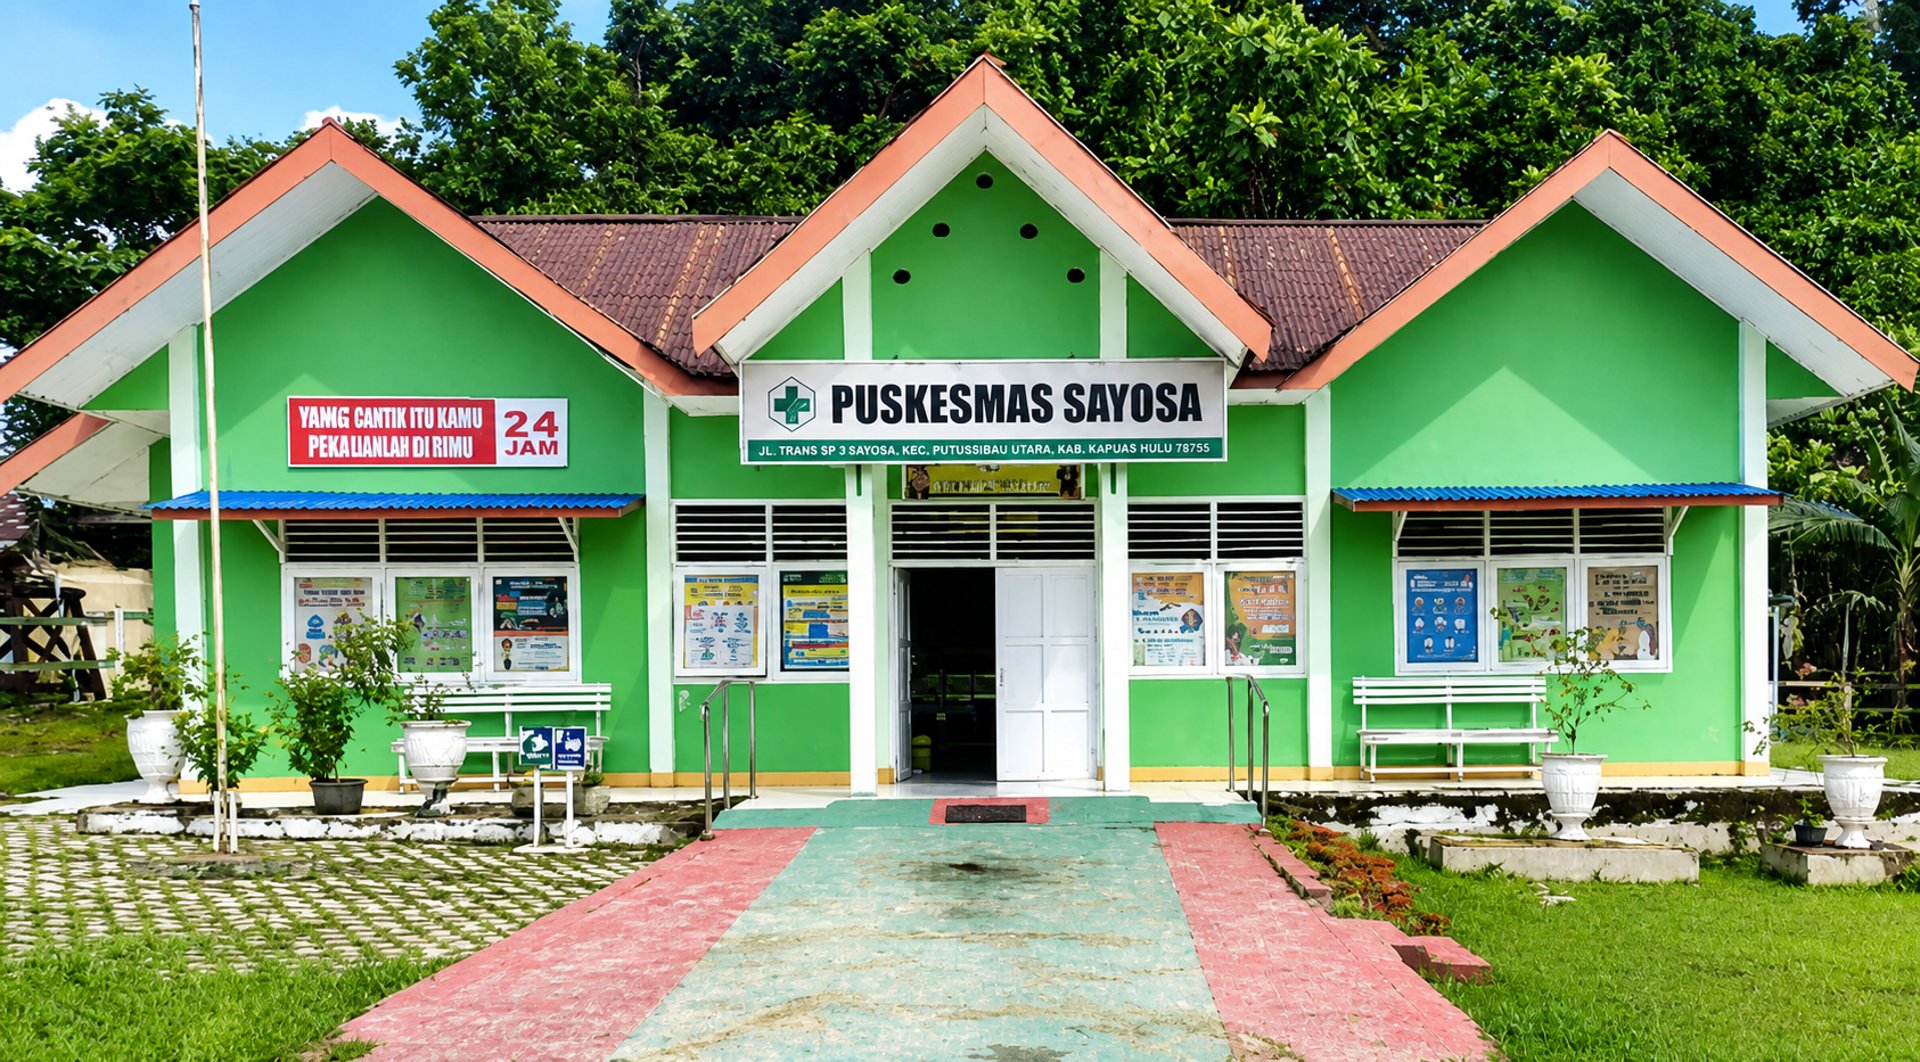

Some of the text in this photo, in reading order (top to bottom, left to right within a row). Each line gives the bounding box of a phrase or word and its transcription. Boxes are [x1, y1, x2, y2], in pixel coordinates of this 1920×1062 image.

[831, 382, 1203, 425] PUSKESMAS SAYOSA
[353, 406, 407, 429] CANTIK
[409, 406, 435, 429] ITU
[437, 406, 483, 429] KAMU
[504, 410, 559, 438] 24
[504, 440, 559, 456] JAM
[758, 446, 776, 456] JL.
[778, 445, 818, 456] TRANS
[820, 445, 836, 456] SP
[839, 445, 846, 456] 3
[902, 445, 930, 456] KEC.
[932, 444, 1008, 455] PUTUSSIBAU
[1057, 444, 1086, 454] KAB.
[1088, 443, 1137, 454] KAPUAS
[1140, 443, 1173, 454] HULU
[1175, 443, 1210, 453] 78755
